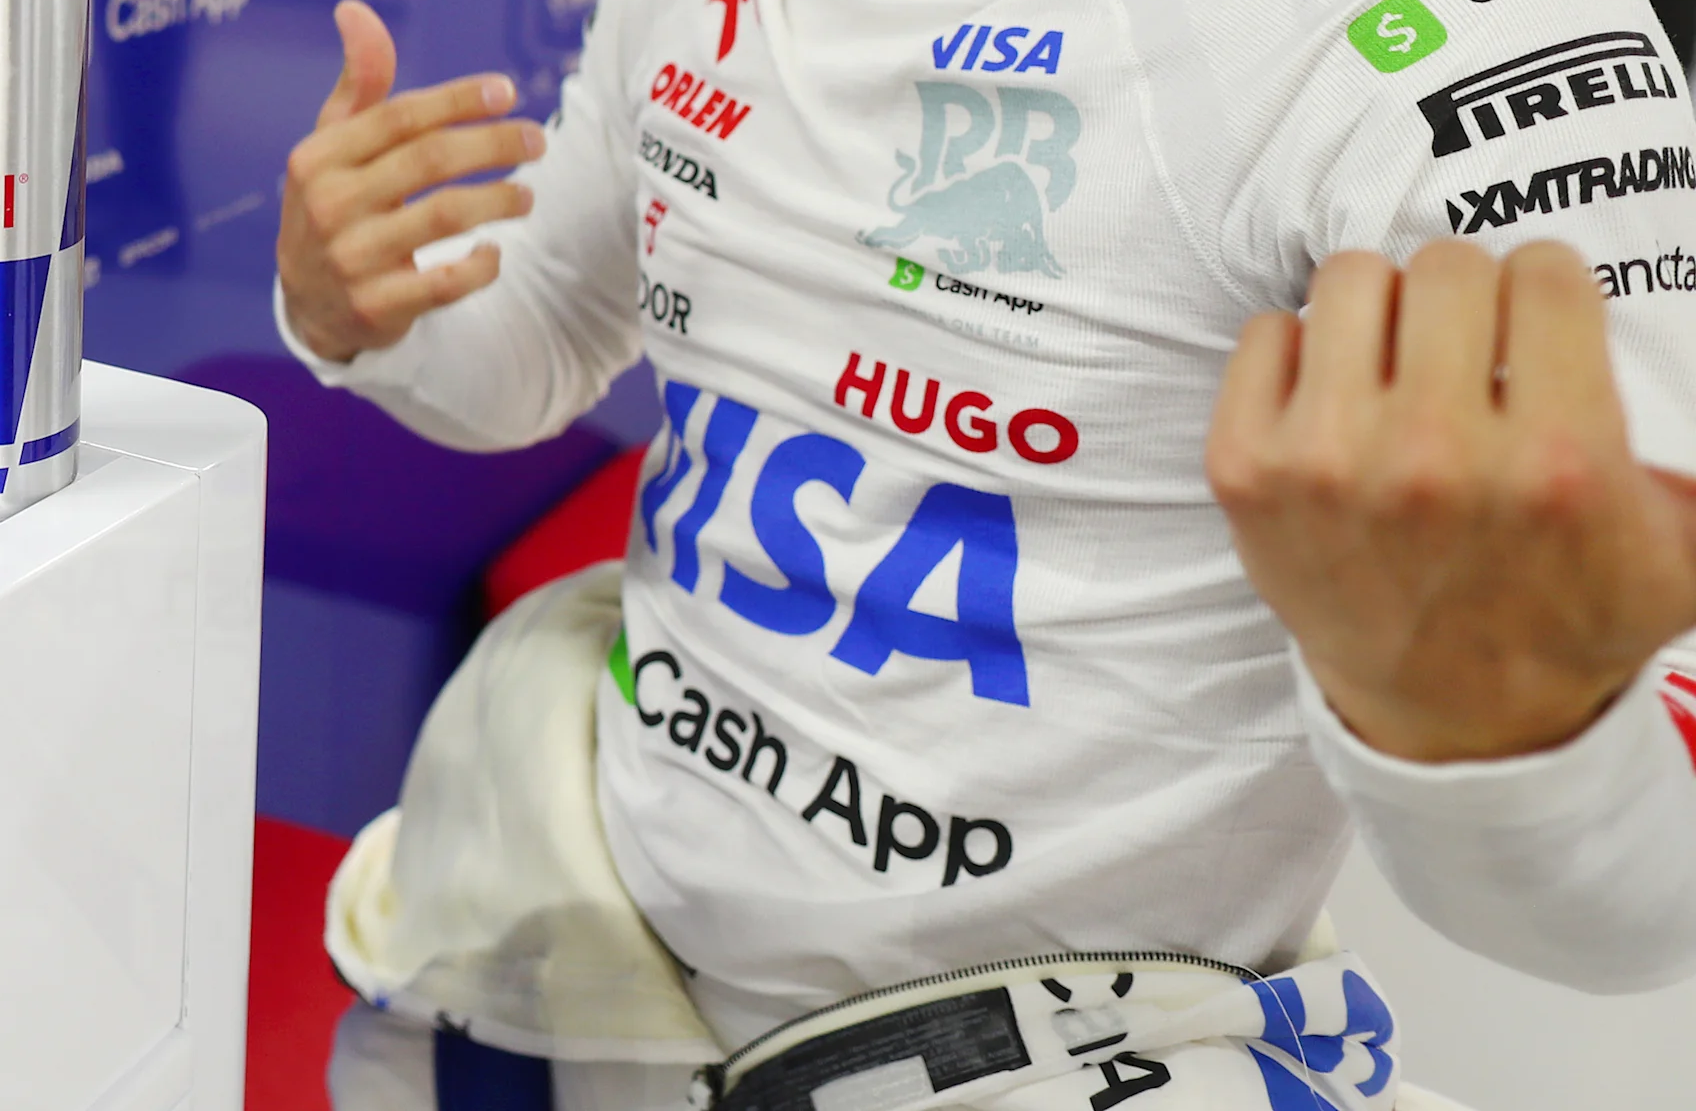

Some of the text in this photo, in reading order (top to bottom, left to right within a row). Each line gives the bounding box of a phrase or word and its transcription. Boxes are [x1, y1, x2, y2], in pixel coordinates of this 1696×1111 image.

[650, 61, 752, 141] ORLEN
[931, 23, 1065, 75] VISA
[1416, 30, 1678, 159] PIRELLI
[637, 129, 719, 202] HONDA
[833, 350, 1079, 464] HUGO
[640, 378, 1032, 709] VISA
[634, 649, 1014, 887] Cash App
